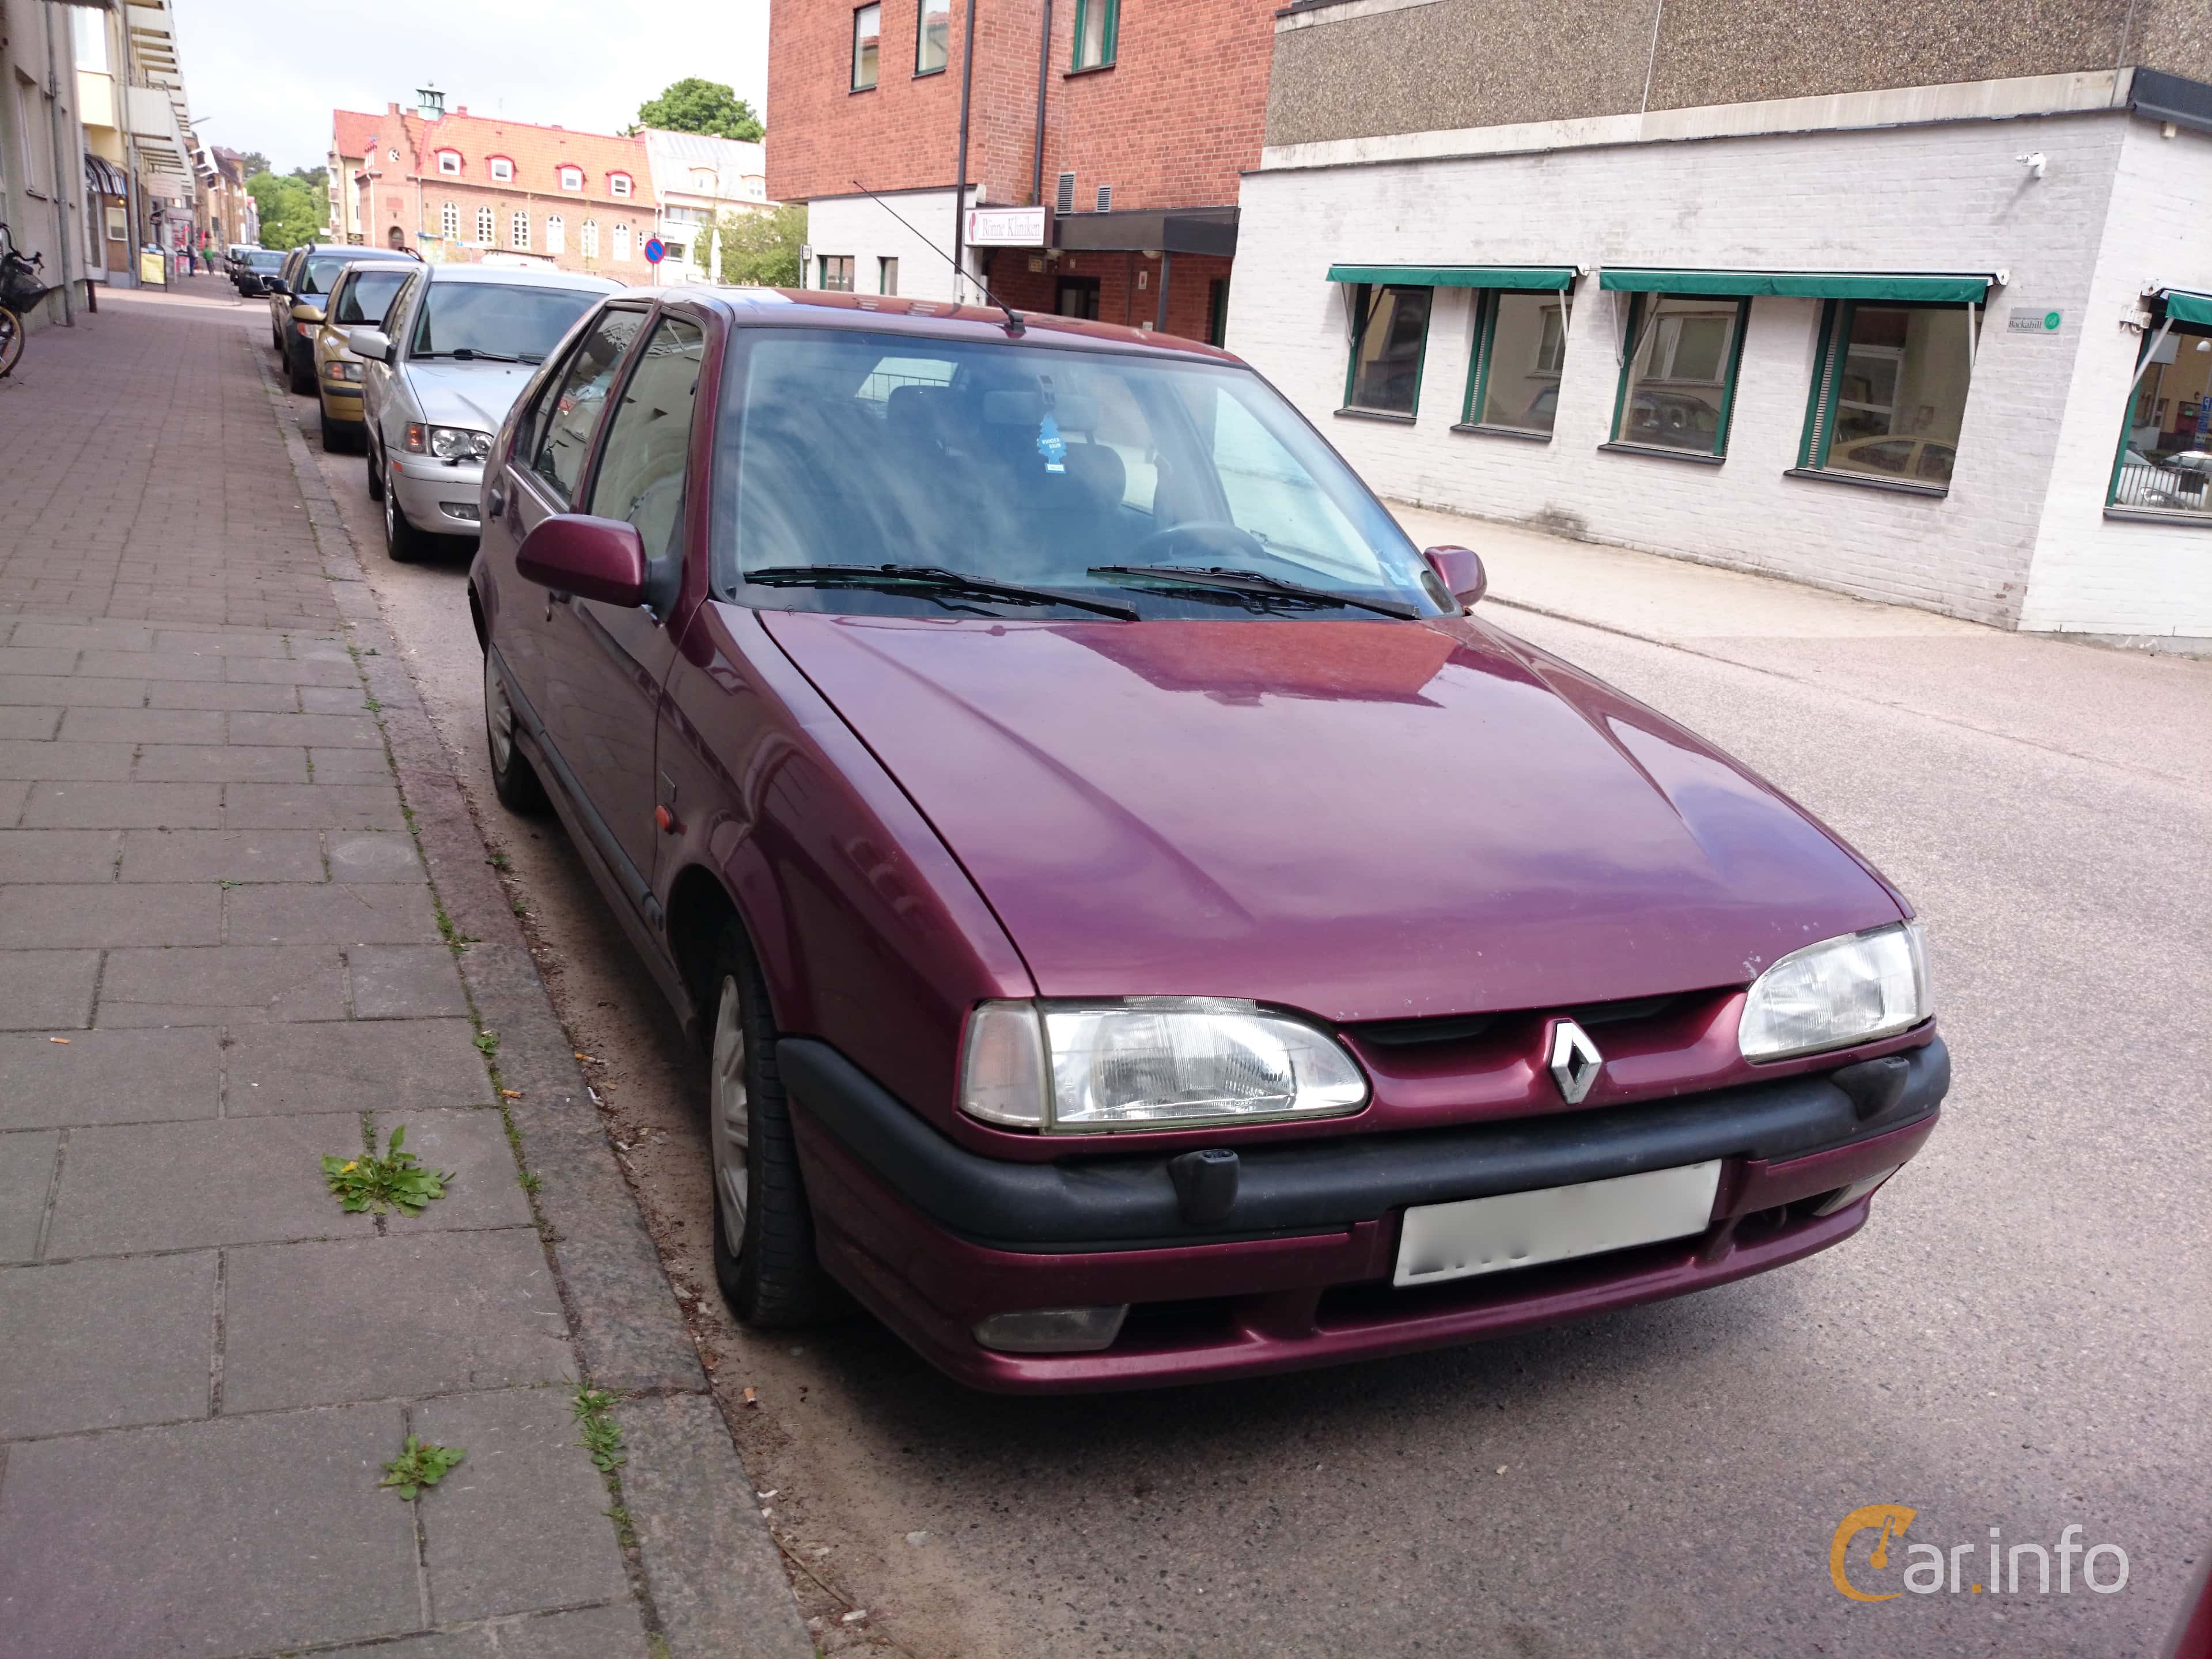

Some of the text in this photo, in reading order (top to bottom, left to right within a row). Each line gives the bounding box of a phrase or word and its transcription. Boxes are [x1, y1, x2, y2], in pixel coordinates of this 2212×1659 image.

[983, 216, 1040, 236] Rönne Kliniken
[2009, 320, 2042, 329] Backahill
